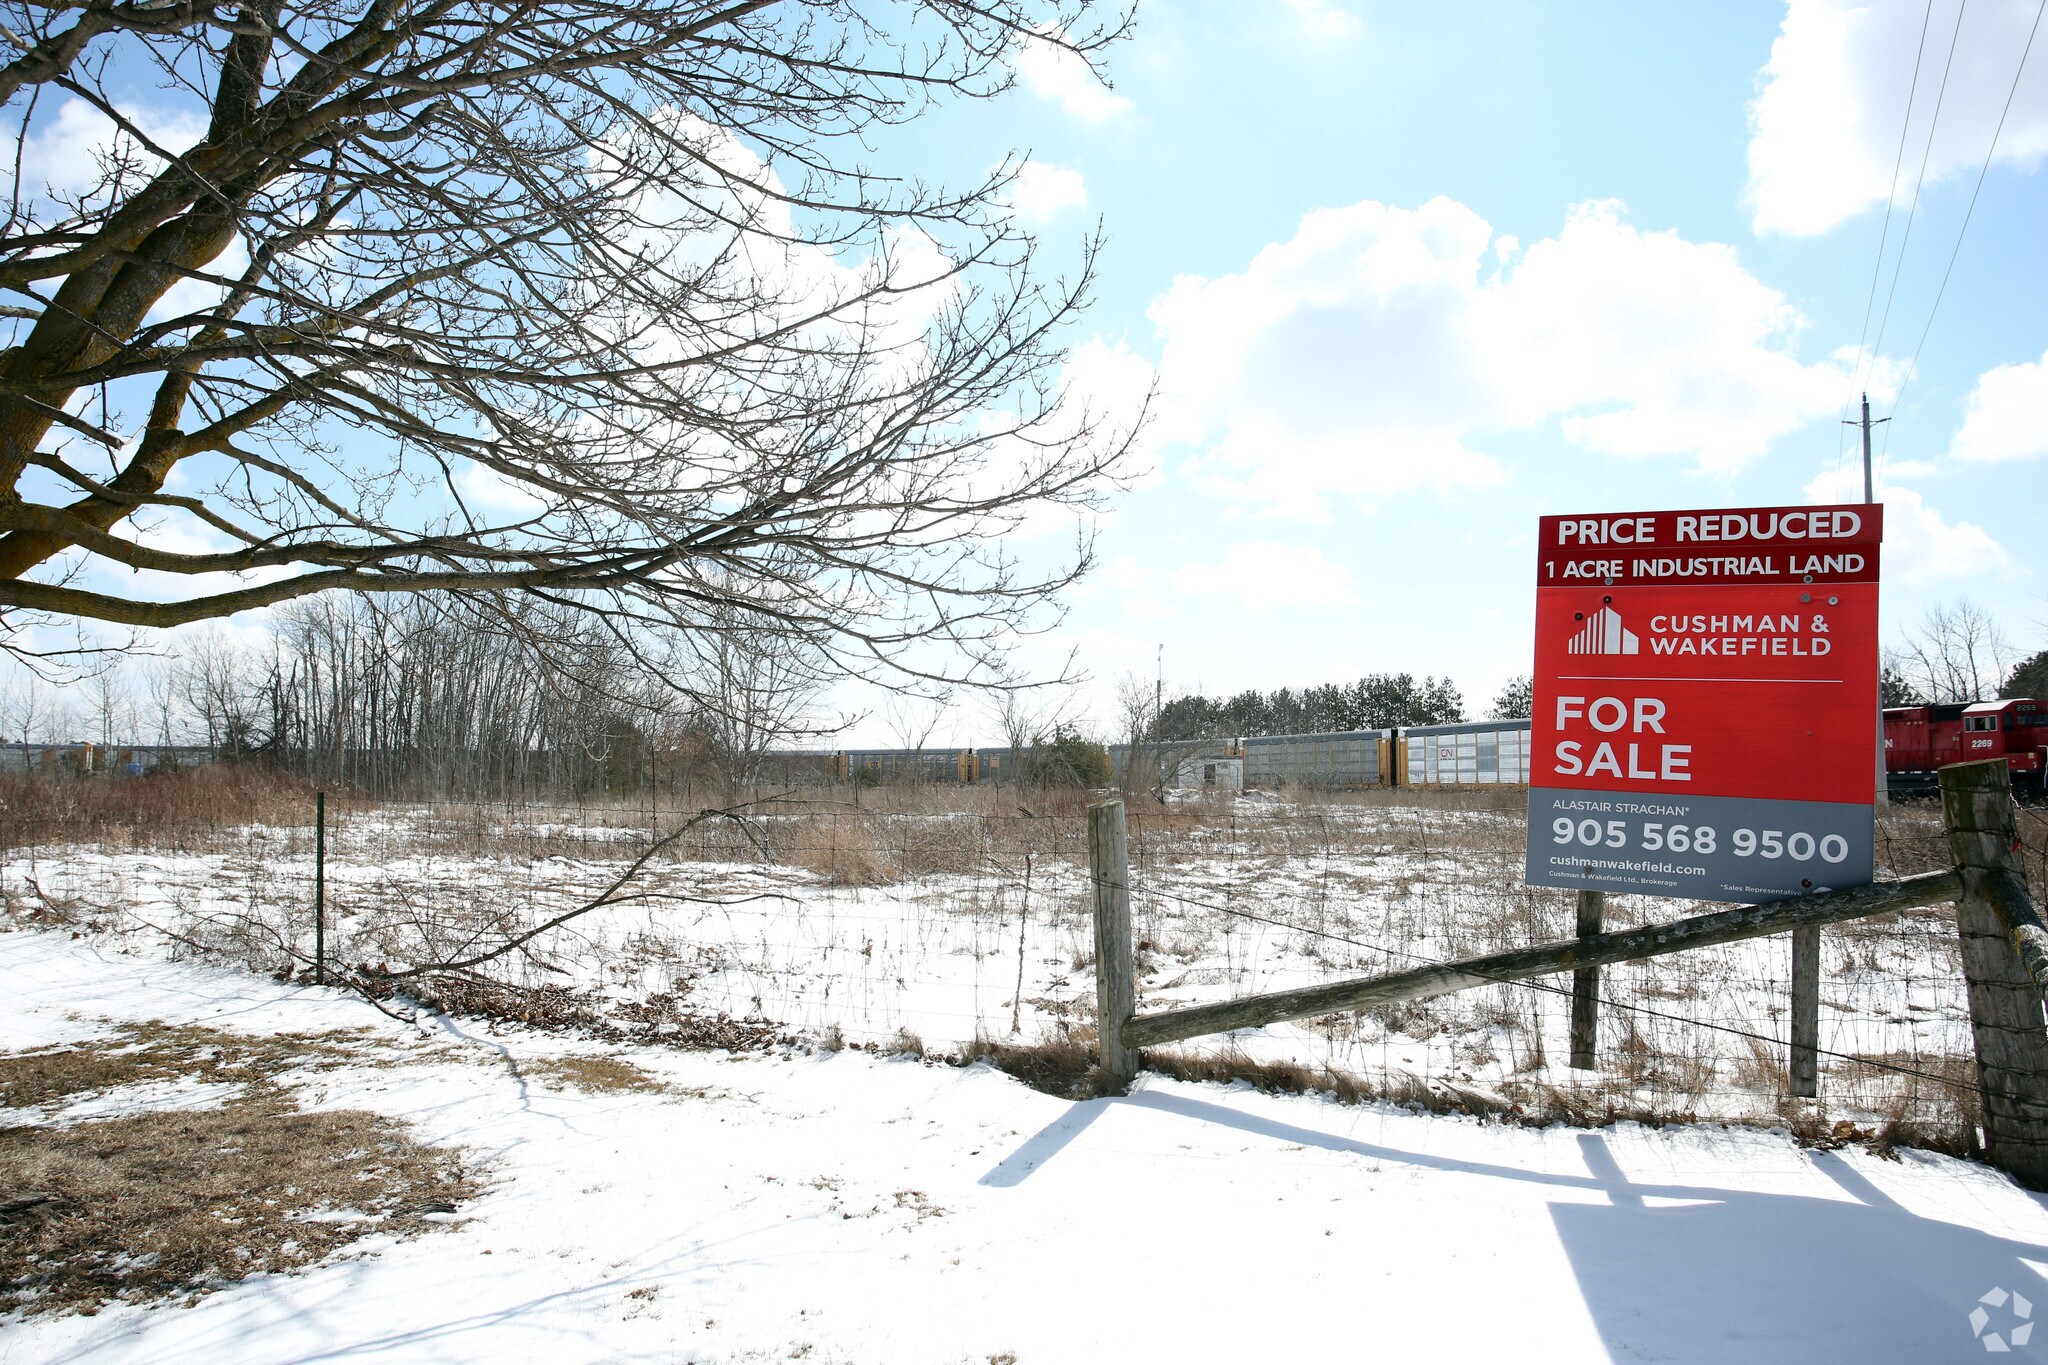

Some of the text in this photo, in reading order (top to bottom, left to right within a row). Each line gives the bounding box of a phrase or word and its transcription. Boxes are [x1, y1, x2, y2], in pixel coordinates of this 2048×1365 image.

[1558, 511, 1862, 546] PRICE REDUCED
[1545, 553, 1865, 578] 1 ACRE INDUSTRIAL LAND
[1650, 614, 1830, 633] CUSHMAN &
[1650, 637, 1831, 656] WAKEFIELD
[1556, 696, 1667, 734] FOR
[1971, 739, 1993, 749] 2269
[1553, 740, 1692, 781] SALE
[1552, 799, 1611, 812] ALASTAIR
[1552, 817, 1849, 864] 905 568 9500
[1549, 855, 1706, 876] cushmanwakefield.com
[1548, 870, 1579, 879] Cushman
[1587, 873, 1622, 882] Wakefield
[1640, 878, 1678, 887] Brokerage
[1744, 886, 1802, 896] Representative
